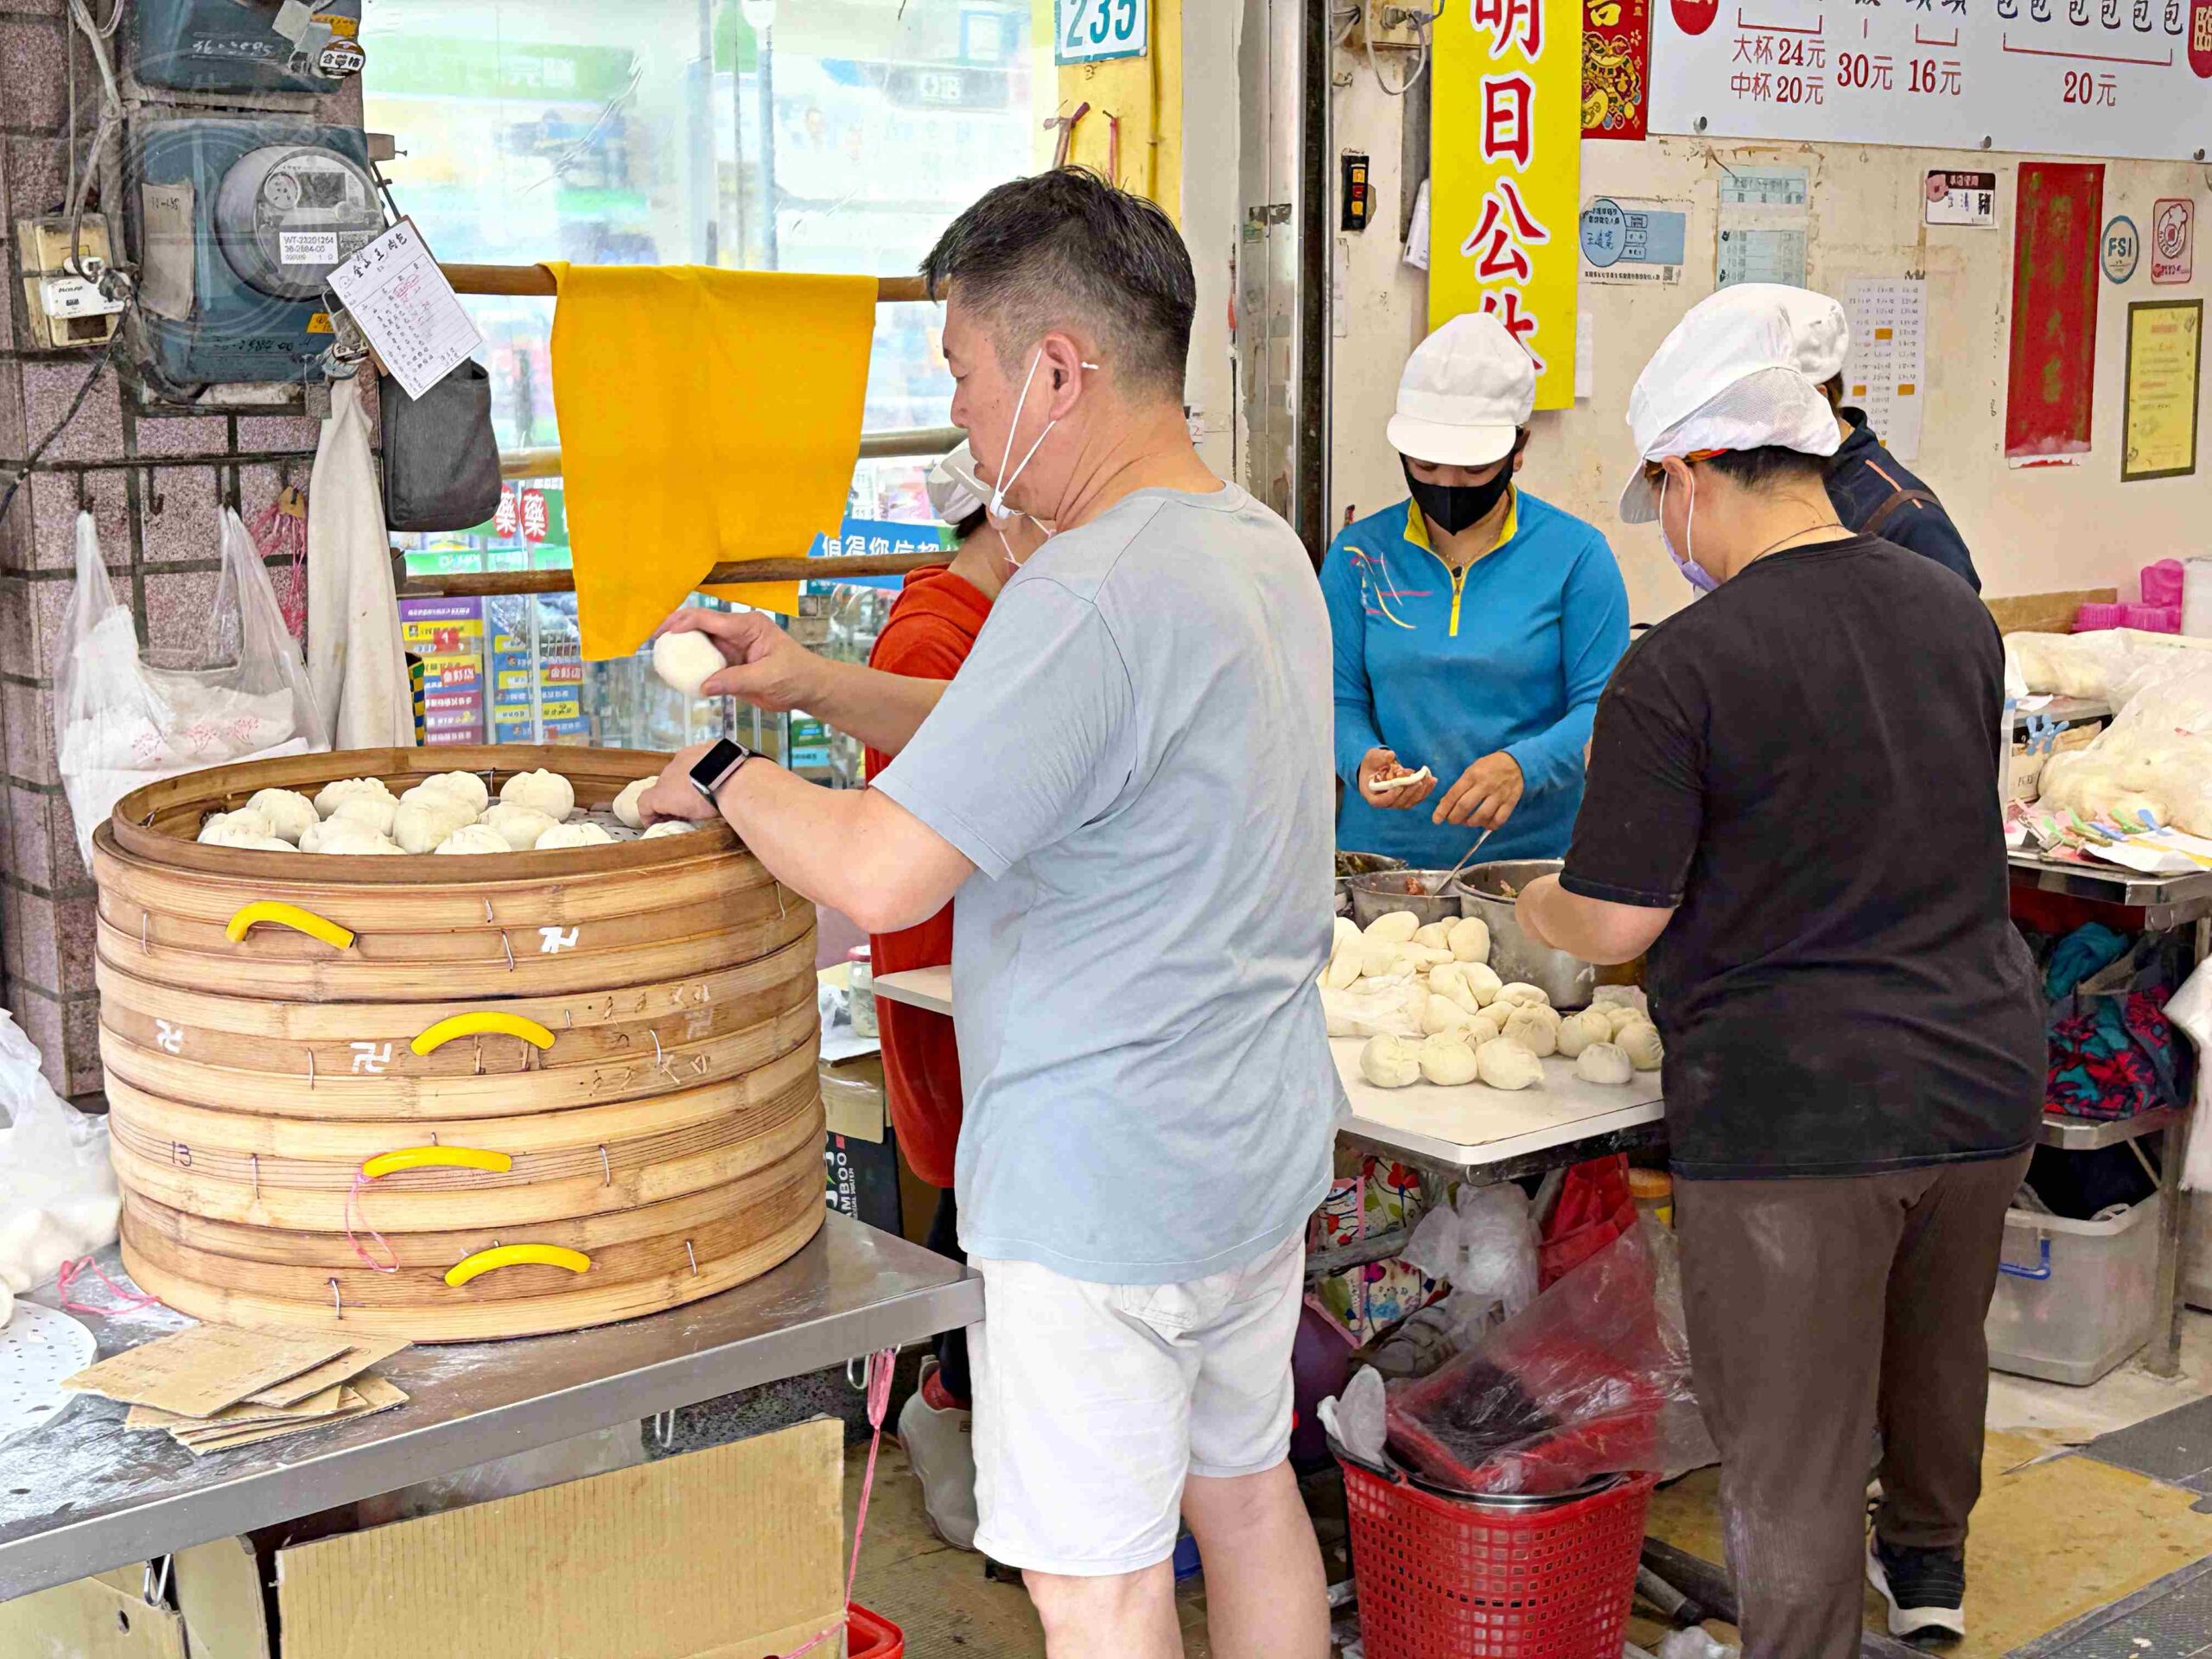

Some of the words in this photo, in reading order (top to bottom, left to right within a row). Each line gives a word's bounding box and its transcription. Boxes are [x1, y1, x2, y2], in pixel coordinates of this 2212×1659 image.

[1066, 0, 1137, 48] 235
[2133, 0, 2152, 32] 包
[2164, 0, 2183, 35] 包
[1836, 52, 1894, 92] 30元
[1907, 57, 1962, 97] 16元
[2062, 71, 2117, 105] 20元
[2107, 237, 2132, 257] FSI
[523, 493, 547, 537] 藥
